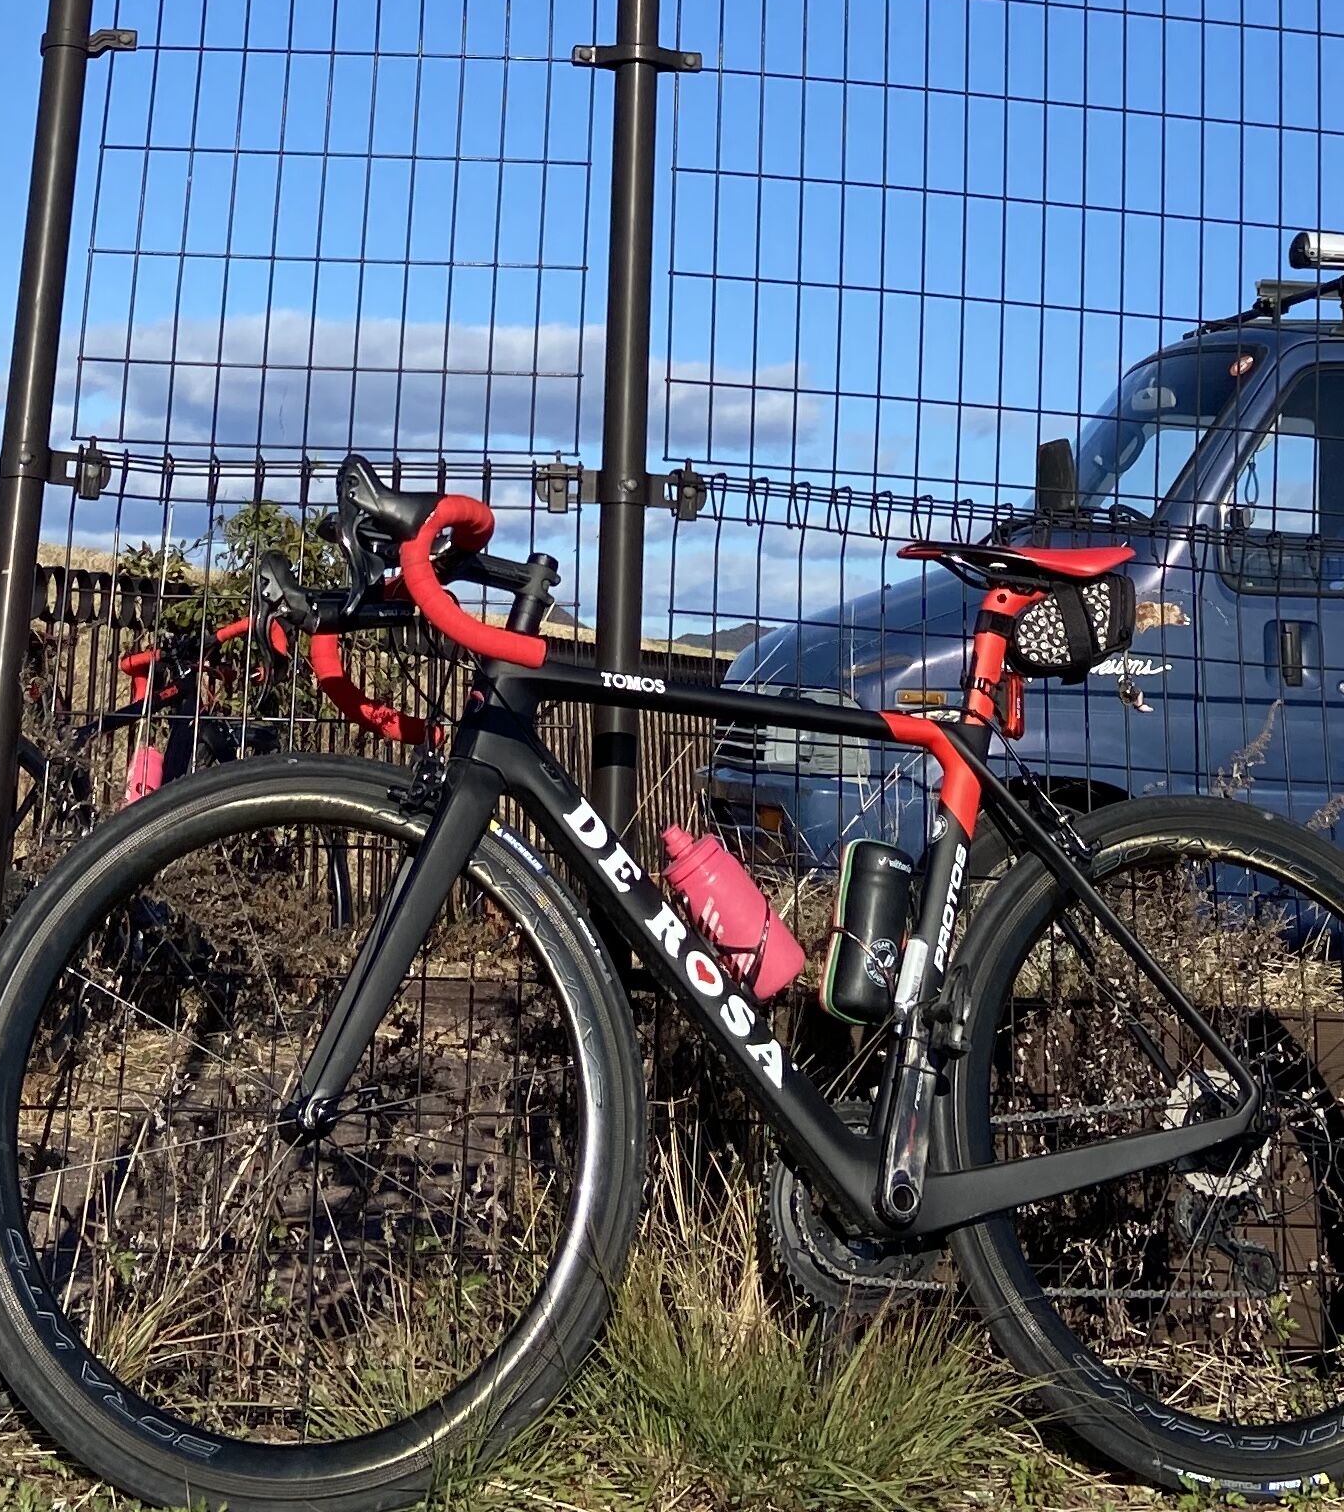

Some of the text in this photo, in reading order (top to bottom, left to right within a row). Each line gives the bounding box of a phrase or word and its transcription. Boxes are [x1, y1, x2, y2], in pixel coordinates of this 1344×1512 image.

[600, 671, 666, 694] TOMOS
[563, 796, 783, 1089] DE ROSA
[933, 843, 967, 974] PROTOS
